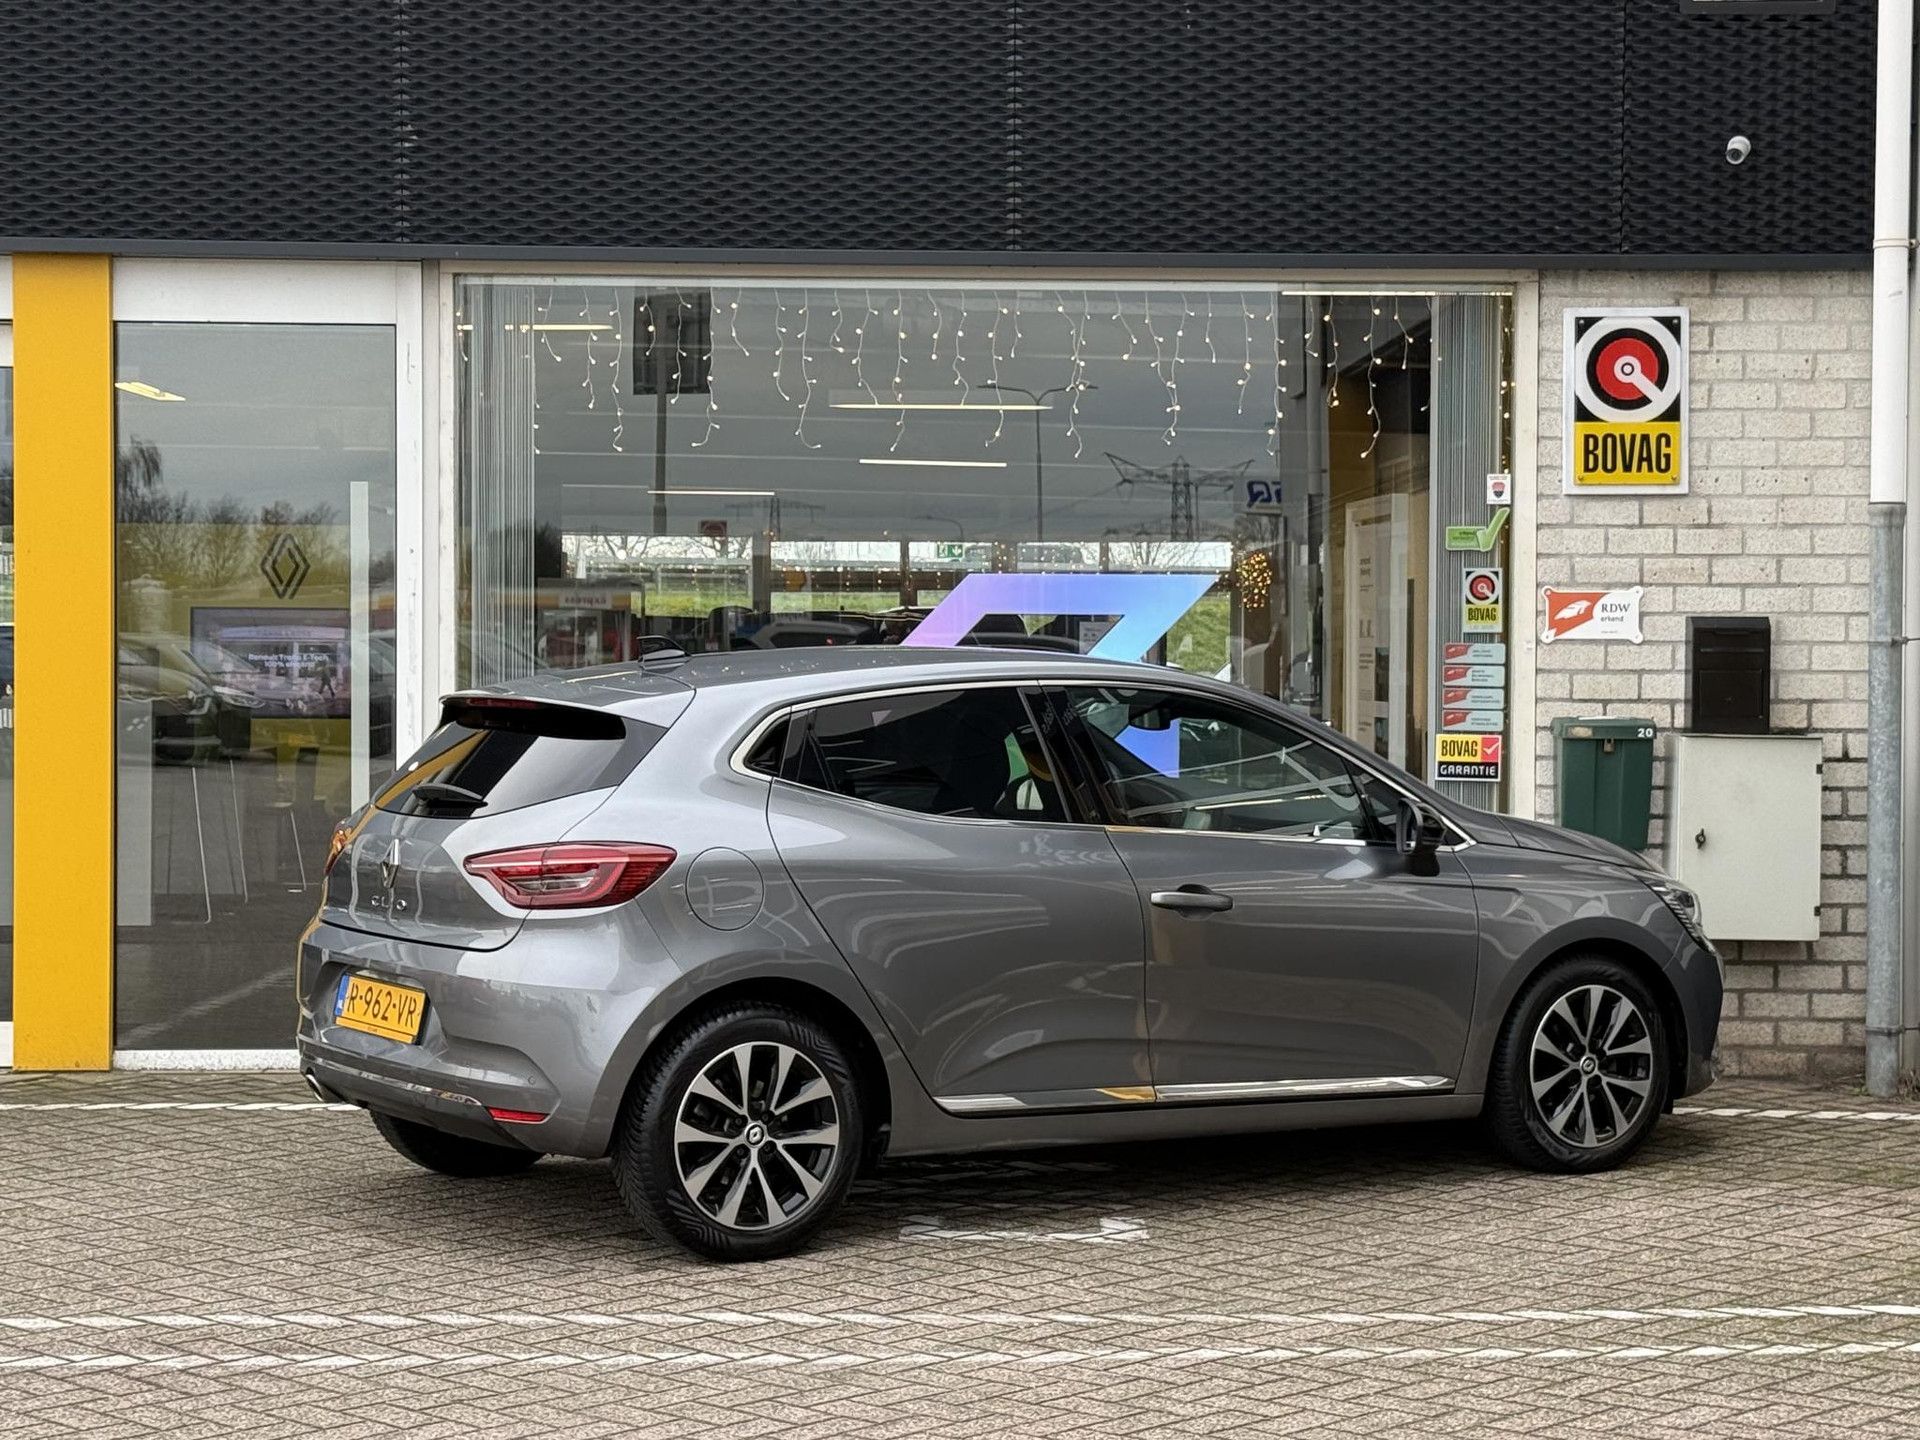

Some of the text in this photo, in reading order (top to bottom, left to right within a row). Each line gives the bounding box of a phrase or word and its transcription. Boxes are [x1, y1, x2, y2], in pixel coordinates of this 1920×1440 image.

[1583, 432, 1671, 473] BOVAG
[1467, 607, 1497, 621] BOVAG
[1601, 603, 1631, 613] RDW
[1637, 728, 1653, 738] 20
[1441, 740, 1478, 757] BOVAG
[1440, 764, 1496, 776] GARANTIE
[347, 982, 417, 1028] R-962-VR
